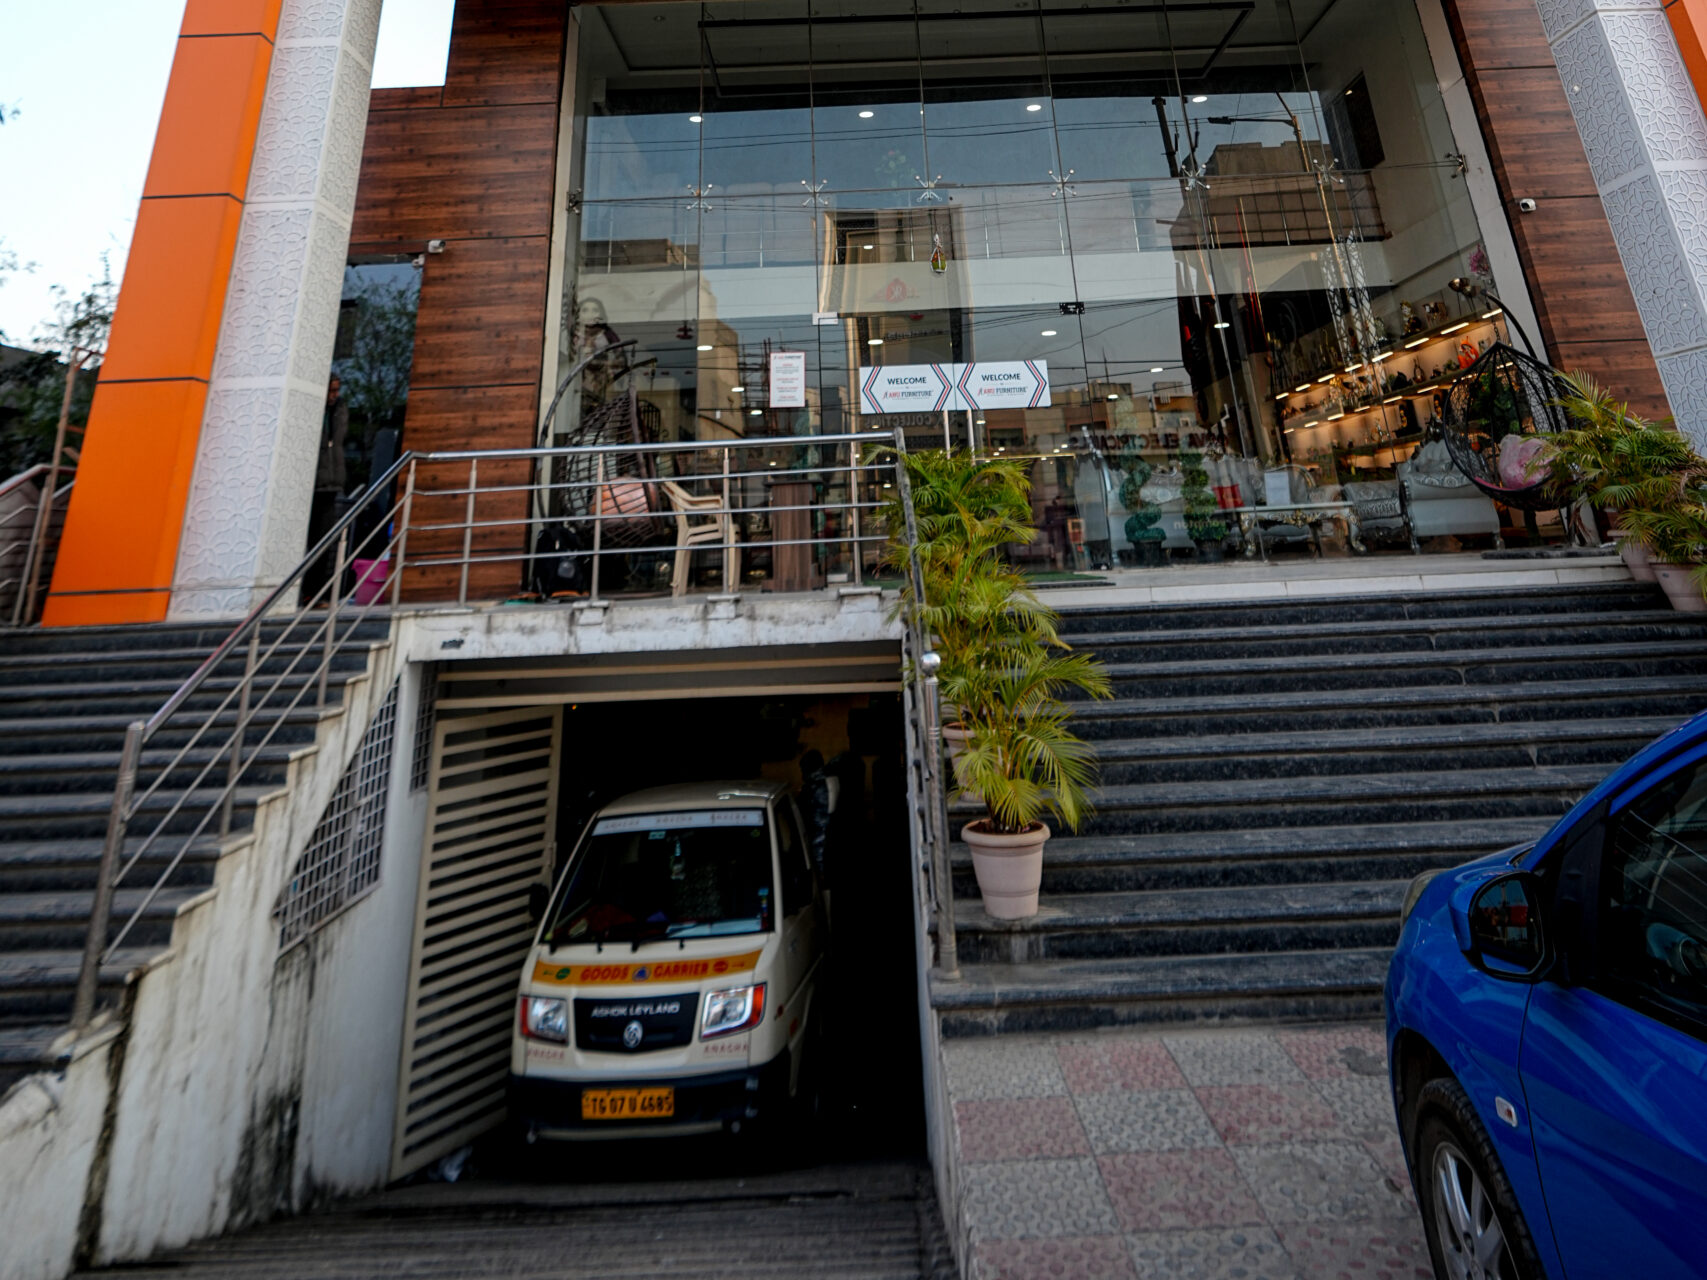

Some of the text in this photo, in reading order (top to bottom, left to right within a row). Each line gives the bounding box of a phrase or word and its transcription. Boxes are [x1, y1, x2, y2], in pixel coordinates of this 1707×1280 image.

[887, 377, 927, 385] WELCOME
[981, 373, 1021, 382] WELCOME
[580, 966, 629, 981] GOODS
[653, 962, 709, 977] CARRIER
[591, 1001, 680, 1018] ASHOK LEYLAND
